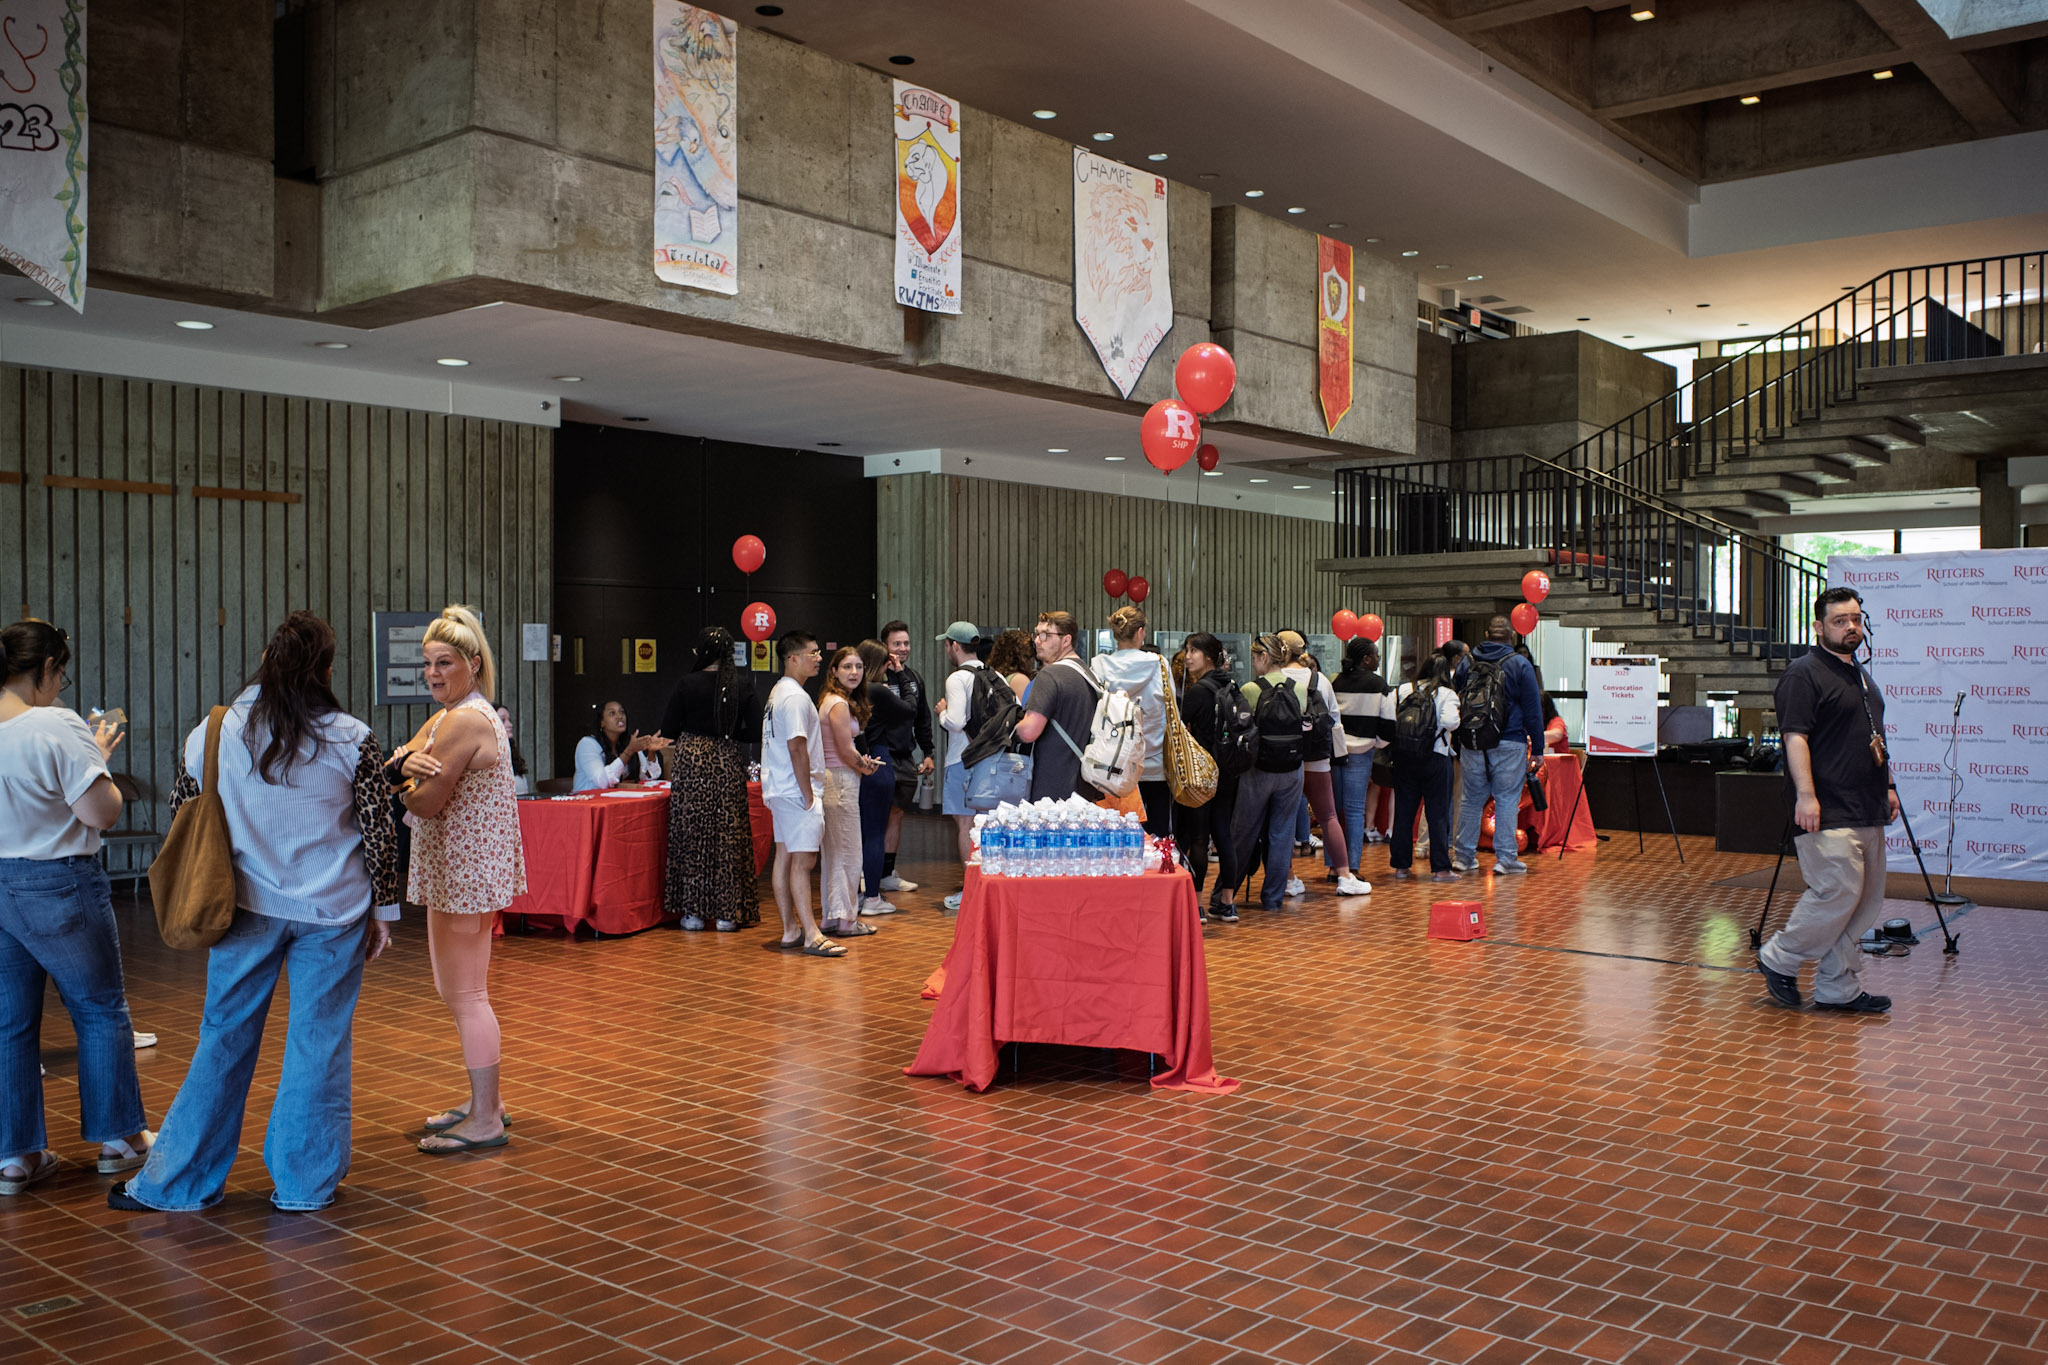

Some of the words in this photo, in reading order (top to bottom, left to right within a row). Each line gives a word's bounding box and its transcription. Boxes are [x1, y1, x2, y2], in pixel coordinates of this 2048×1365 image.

[0, 103, 59, 151] 23
[1076, 152, 1133, 189] CHAMPE
[1154, 178, 1165, 195] R
[899, 285, 940, 310] RWJMS
[1164, 408, 1195, 441] R
[1172, 440, 1189, 449] SHP
[1844, 571, 1900, 586] RUTGERS
[1927, 568, 1985, 583] RUTGERS
[2013, 565, 2048, 580] RUTG
[1539, 577, 1549, 589] R
[755, 613, 769, 627] R
[1887, 608, 1943, 622] RUTGERS
[1971, 606, 2031, 621] RUTGERS
[1926, 646, 1985, 661] RUTGERS
[2013, 645, 2048, 660] RUTG
[1885, 684, 1943, 699] RUTGERS
[1971, 684, 2031, 700] RUTGERS
[2012, 724, 2048, 740] RUTG
[1969, 763, 2029, 778] RUTGERS
[2010, 803, 2047, 819] RUTG
[1966, 840, 2026, 856] RUTGERS
